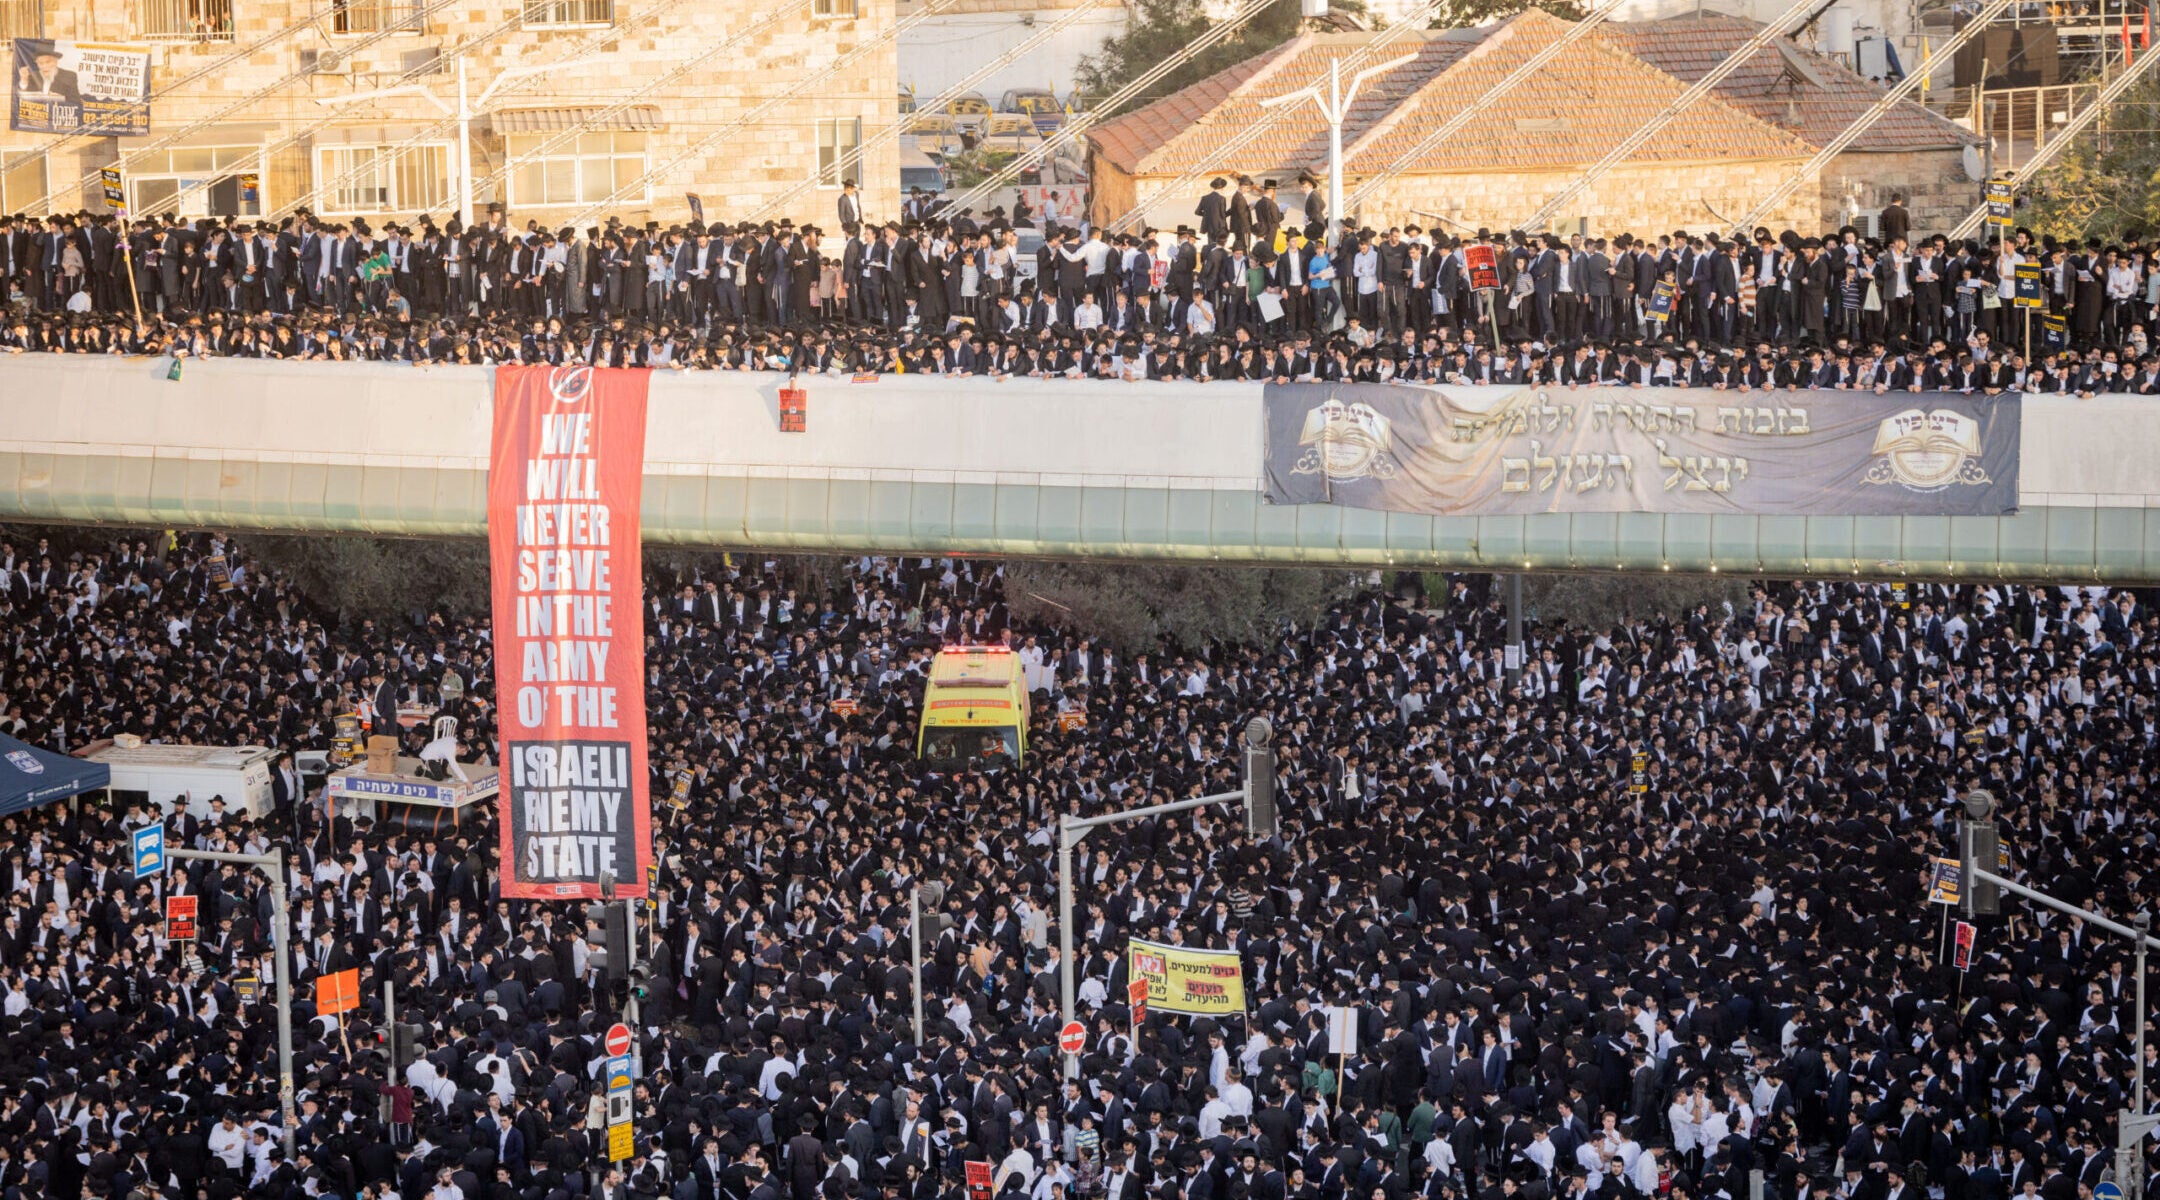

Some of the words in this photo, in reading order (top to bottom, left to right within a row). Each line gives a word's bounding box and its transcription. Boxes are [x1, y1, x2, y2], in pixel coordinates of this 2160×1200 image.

[541, 414, 592, 454] WE
[1593, 403, 1696, 434] התורה
[1714, 406, 1810, 435] בזכות
[527, 459, 600, 500] WILL
[1501, 439, 1633, 495] העולם
[1656, 438, 1750, 493] ינצל
[517, 504, 610, 546] NEVER
[517, 548, 611, 592] SERVE
[522, 640, 609, 682] ARMY
[555, 685, 618, 728] THE
[356, 780, 399, 794] לשתיה
[512, 745, 628, 788] ISRAELI
[403, 785, 427, 797] מים
[524, 790, 621, 833] ENEMY
[527, 835, 618, 878] STATE
